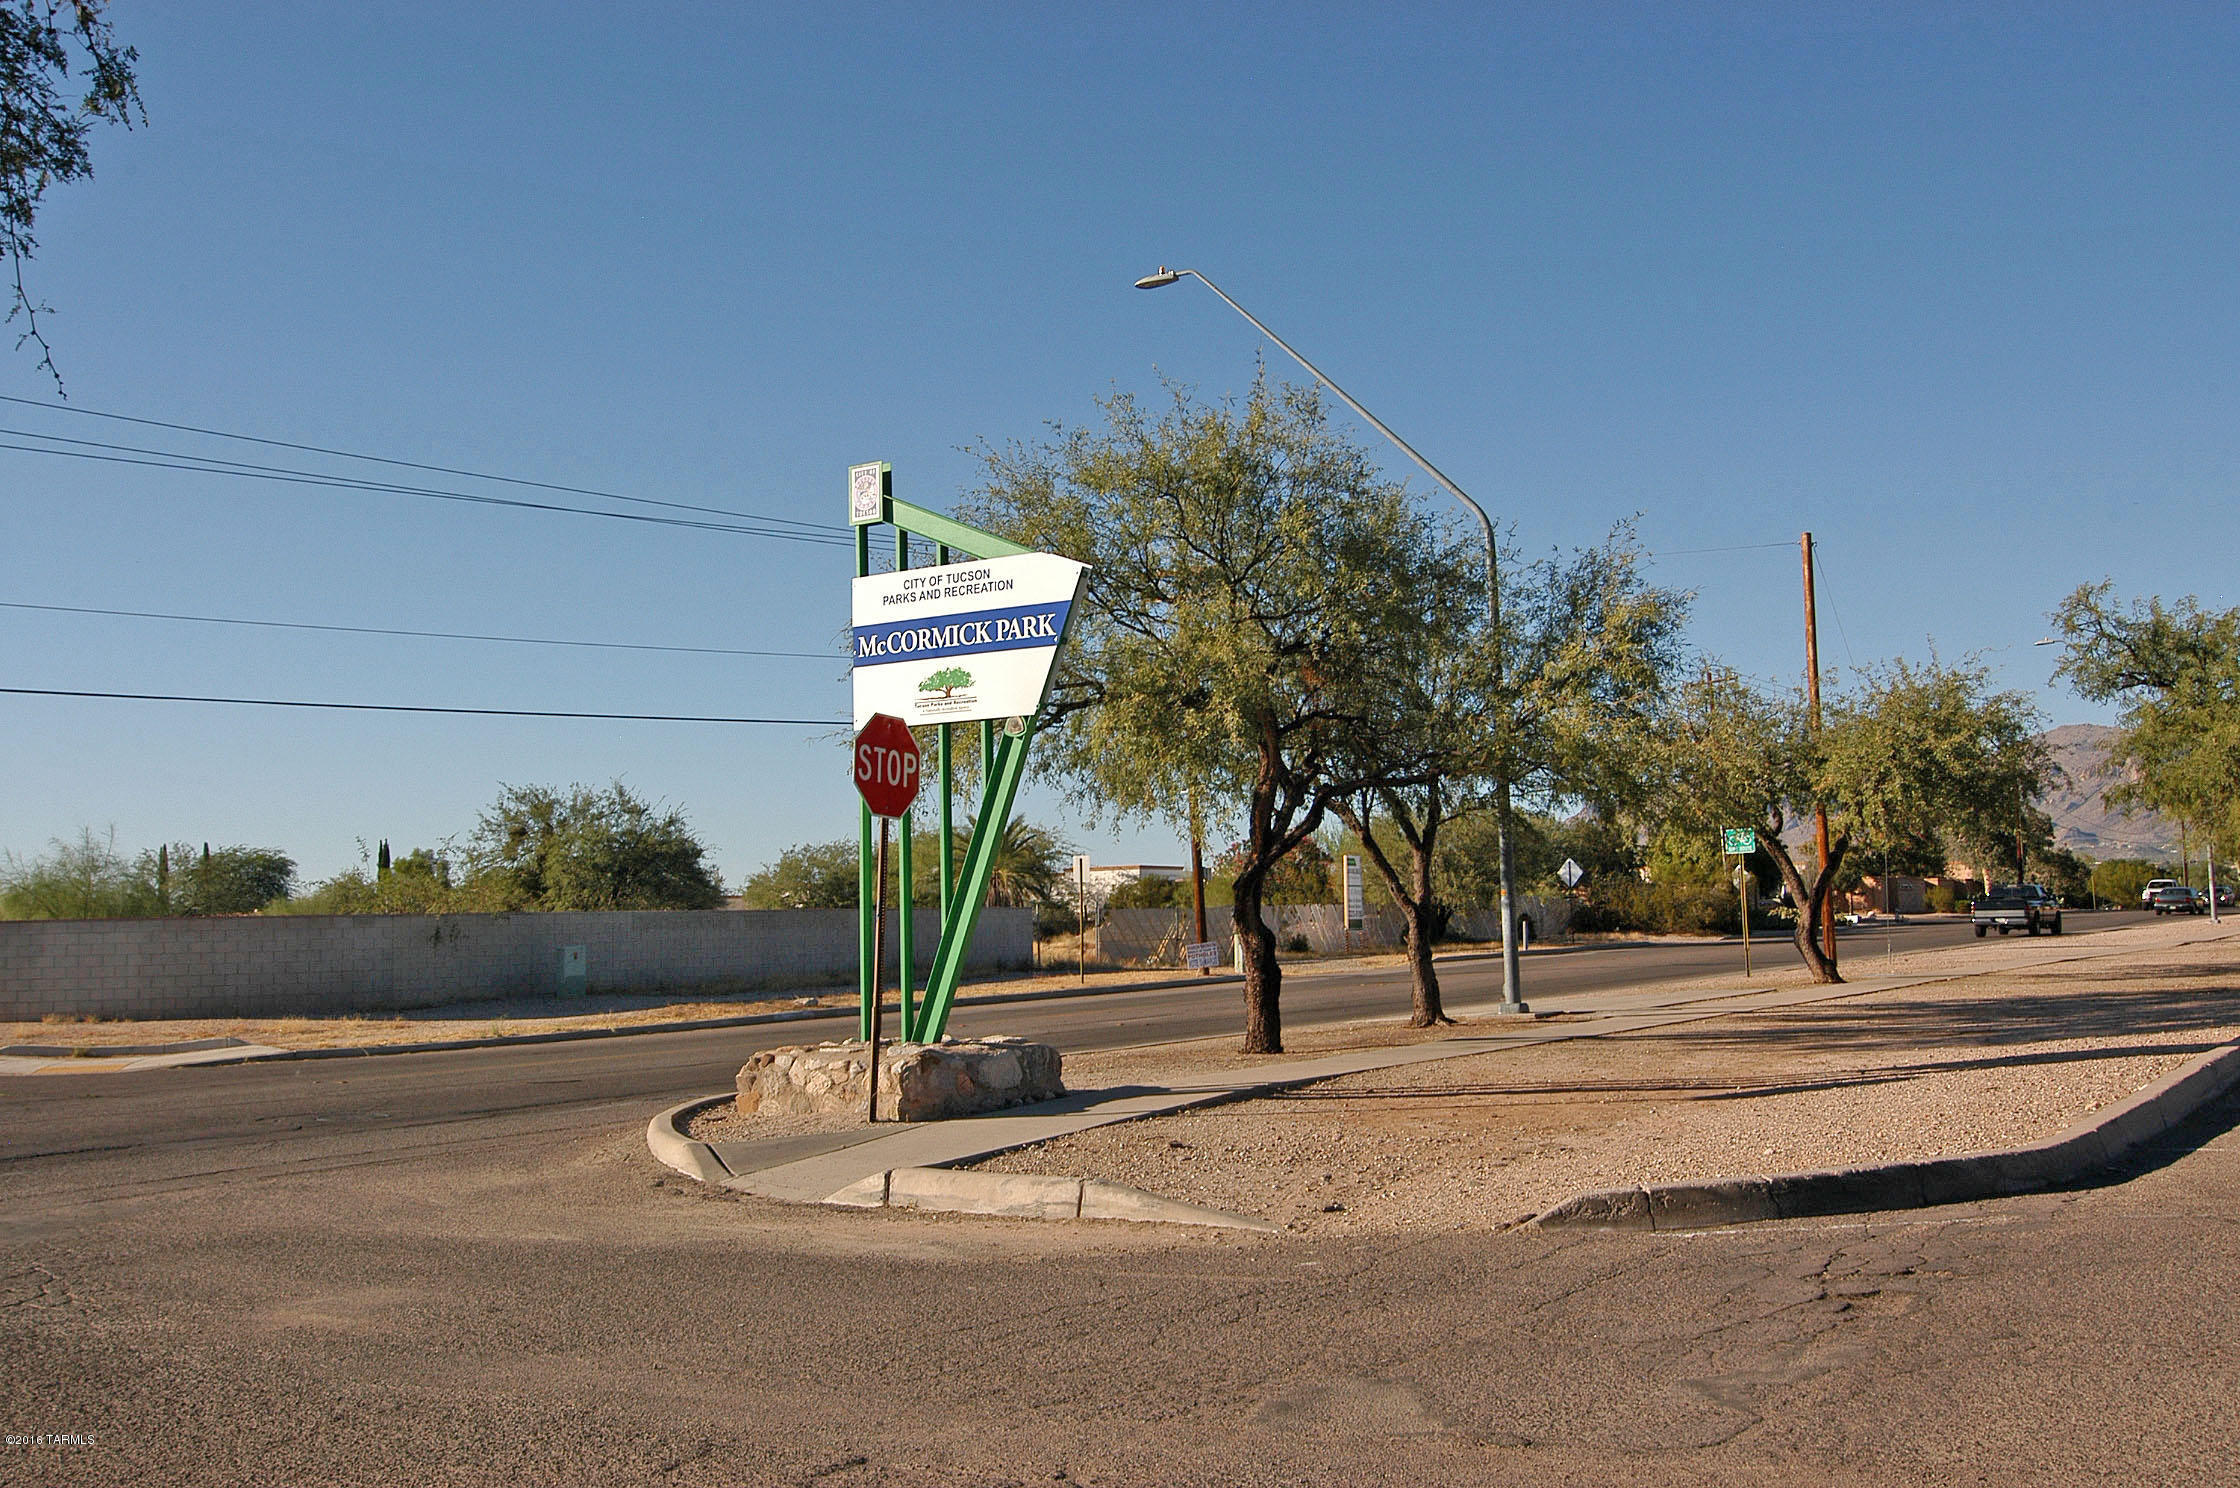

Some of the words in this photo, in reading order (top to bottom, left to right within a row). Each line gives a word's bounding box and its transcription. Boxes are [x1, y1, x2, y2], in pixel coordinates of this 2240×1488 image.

[882, 592, 917, 606] PARKS
[919, 588, 941, 602] AND
[944, 579, 1014, 599] RECREATION
[903, 578, 927, 590] CITY
[928, 575, 943, 587] OF
[946, 568, 991, 585] TUCSON
[858, 620, 992, 659] McCORMICK
[995, 613, 1057, 642] PARK
[858, 744, 917, 788] STOP
